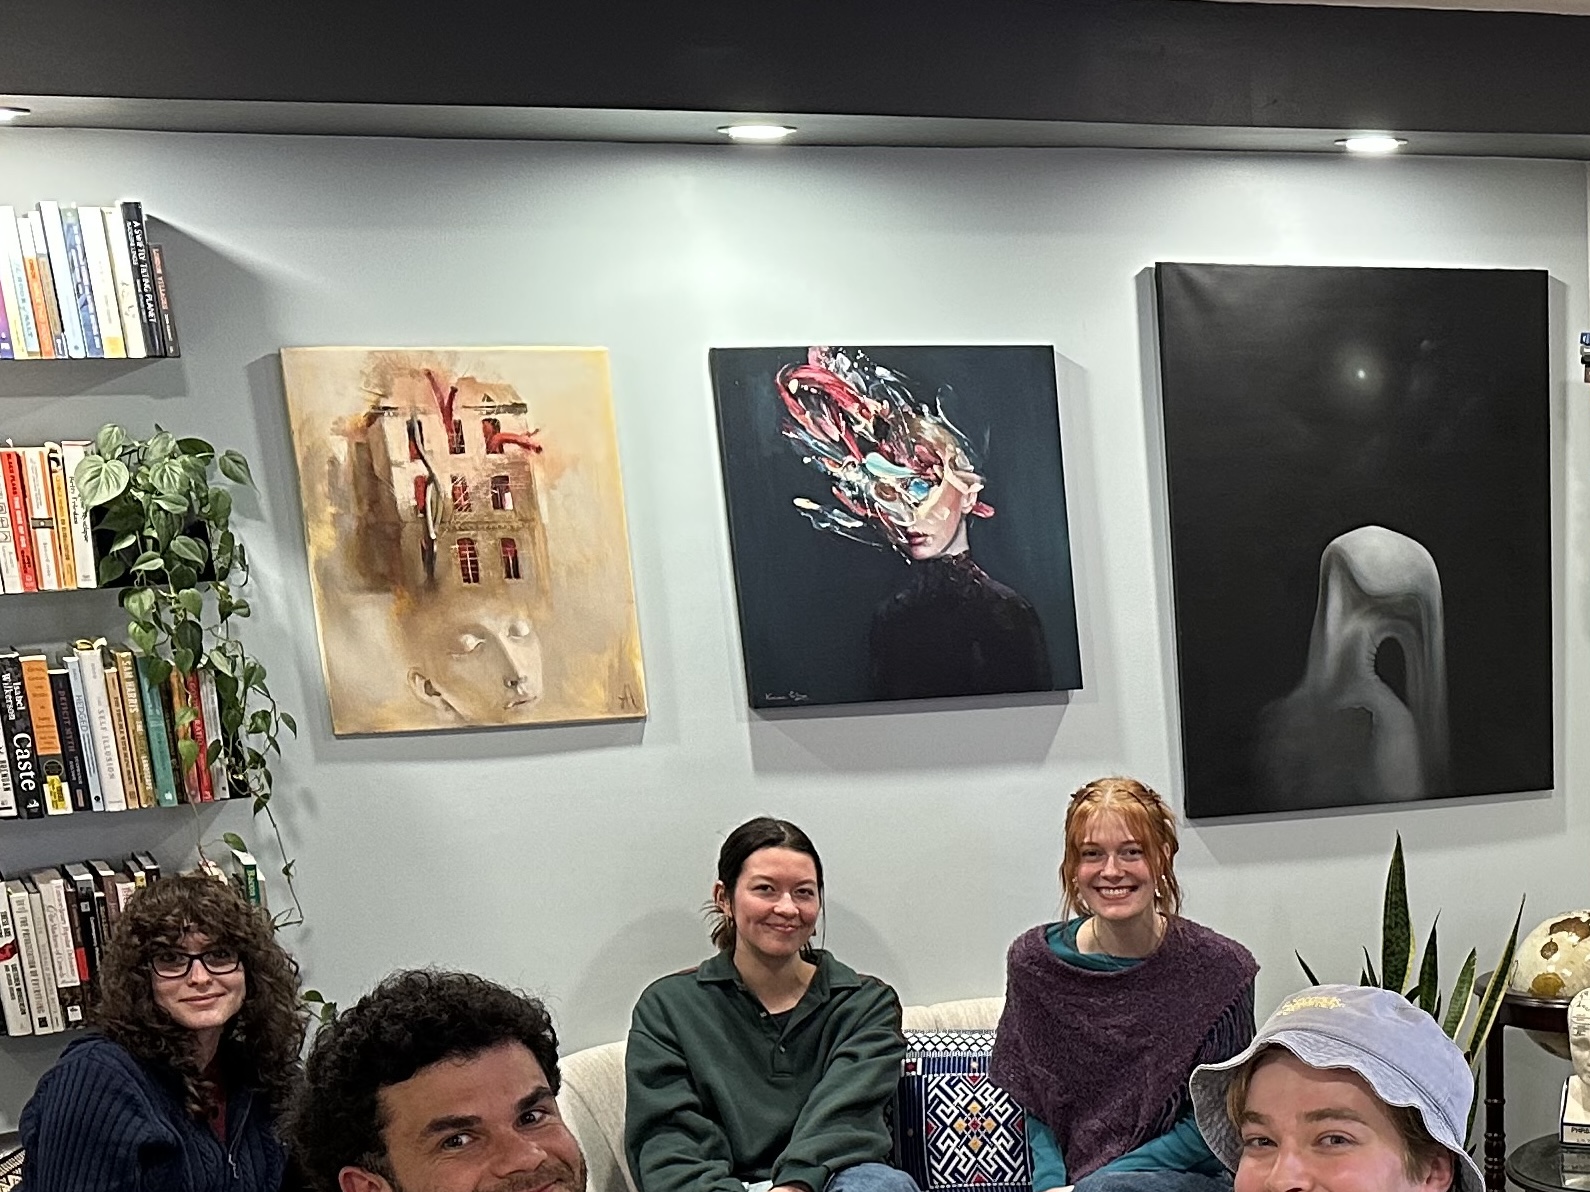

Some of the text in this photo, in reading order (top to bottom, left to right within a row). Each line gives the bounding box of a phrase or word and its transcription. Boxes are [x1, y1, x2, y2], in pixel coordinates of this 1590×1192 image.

[132, 220, 141, 228] A
[134, 228, 146, 261] SWIFTLY
[145, 293, 156, 324] PLANET
[122, 660, 133, 679] SAM
[1, 673, 15, 720] Wilkerson
[13, 682, 25, 710] Isabel
[125, 680, 139, 714] HARRIS
[75, 694, 88, 732] HEDGED
[97, 708, 108, 732] SELF
[13, 733, 36, 791] Caste
[101, 735, 117, 780] ILLUSION
